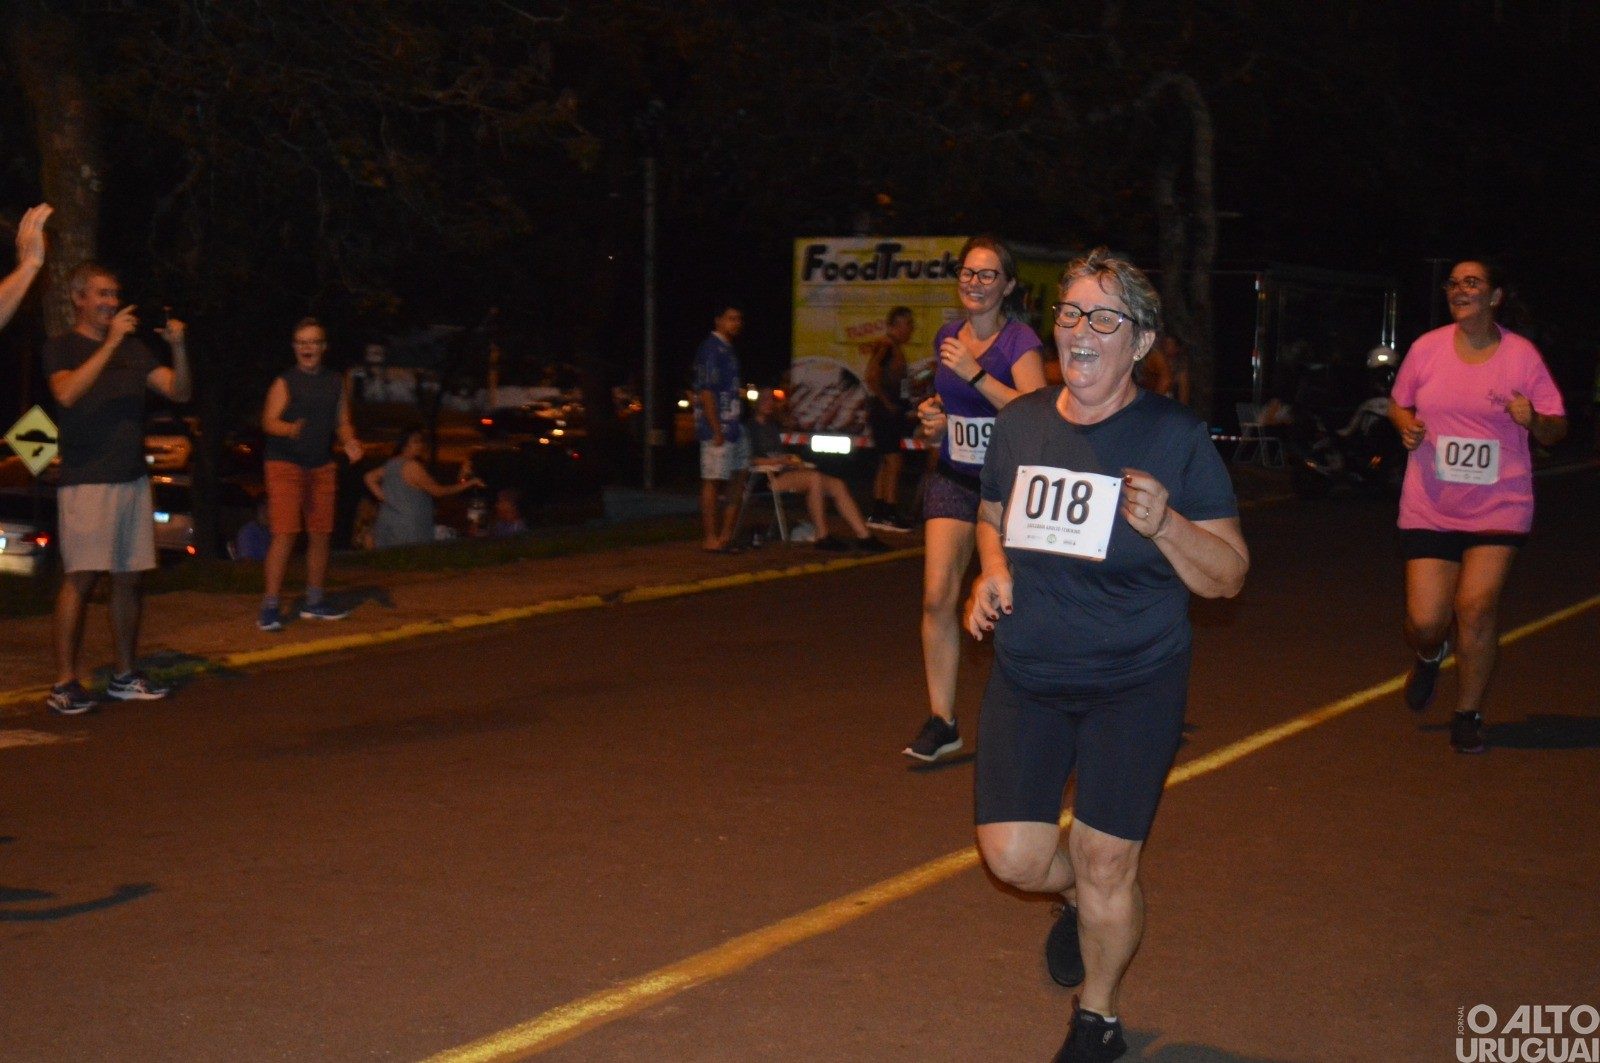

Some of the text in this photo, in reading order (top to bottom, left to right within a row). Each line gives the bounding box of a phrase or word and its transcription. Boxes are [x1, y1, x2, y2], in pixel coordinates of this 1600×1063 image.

[954, 421, 993, 448] 009
[1445, 441, 1491, 469] 020
[1025, 474, 1094, 525] 018
